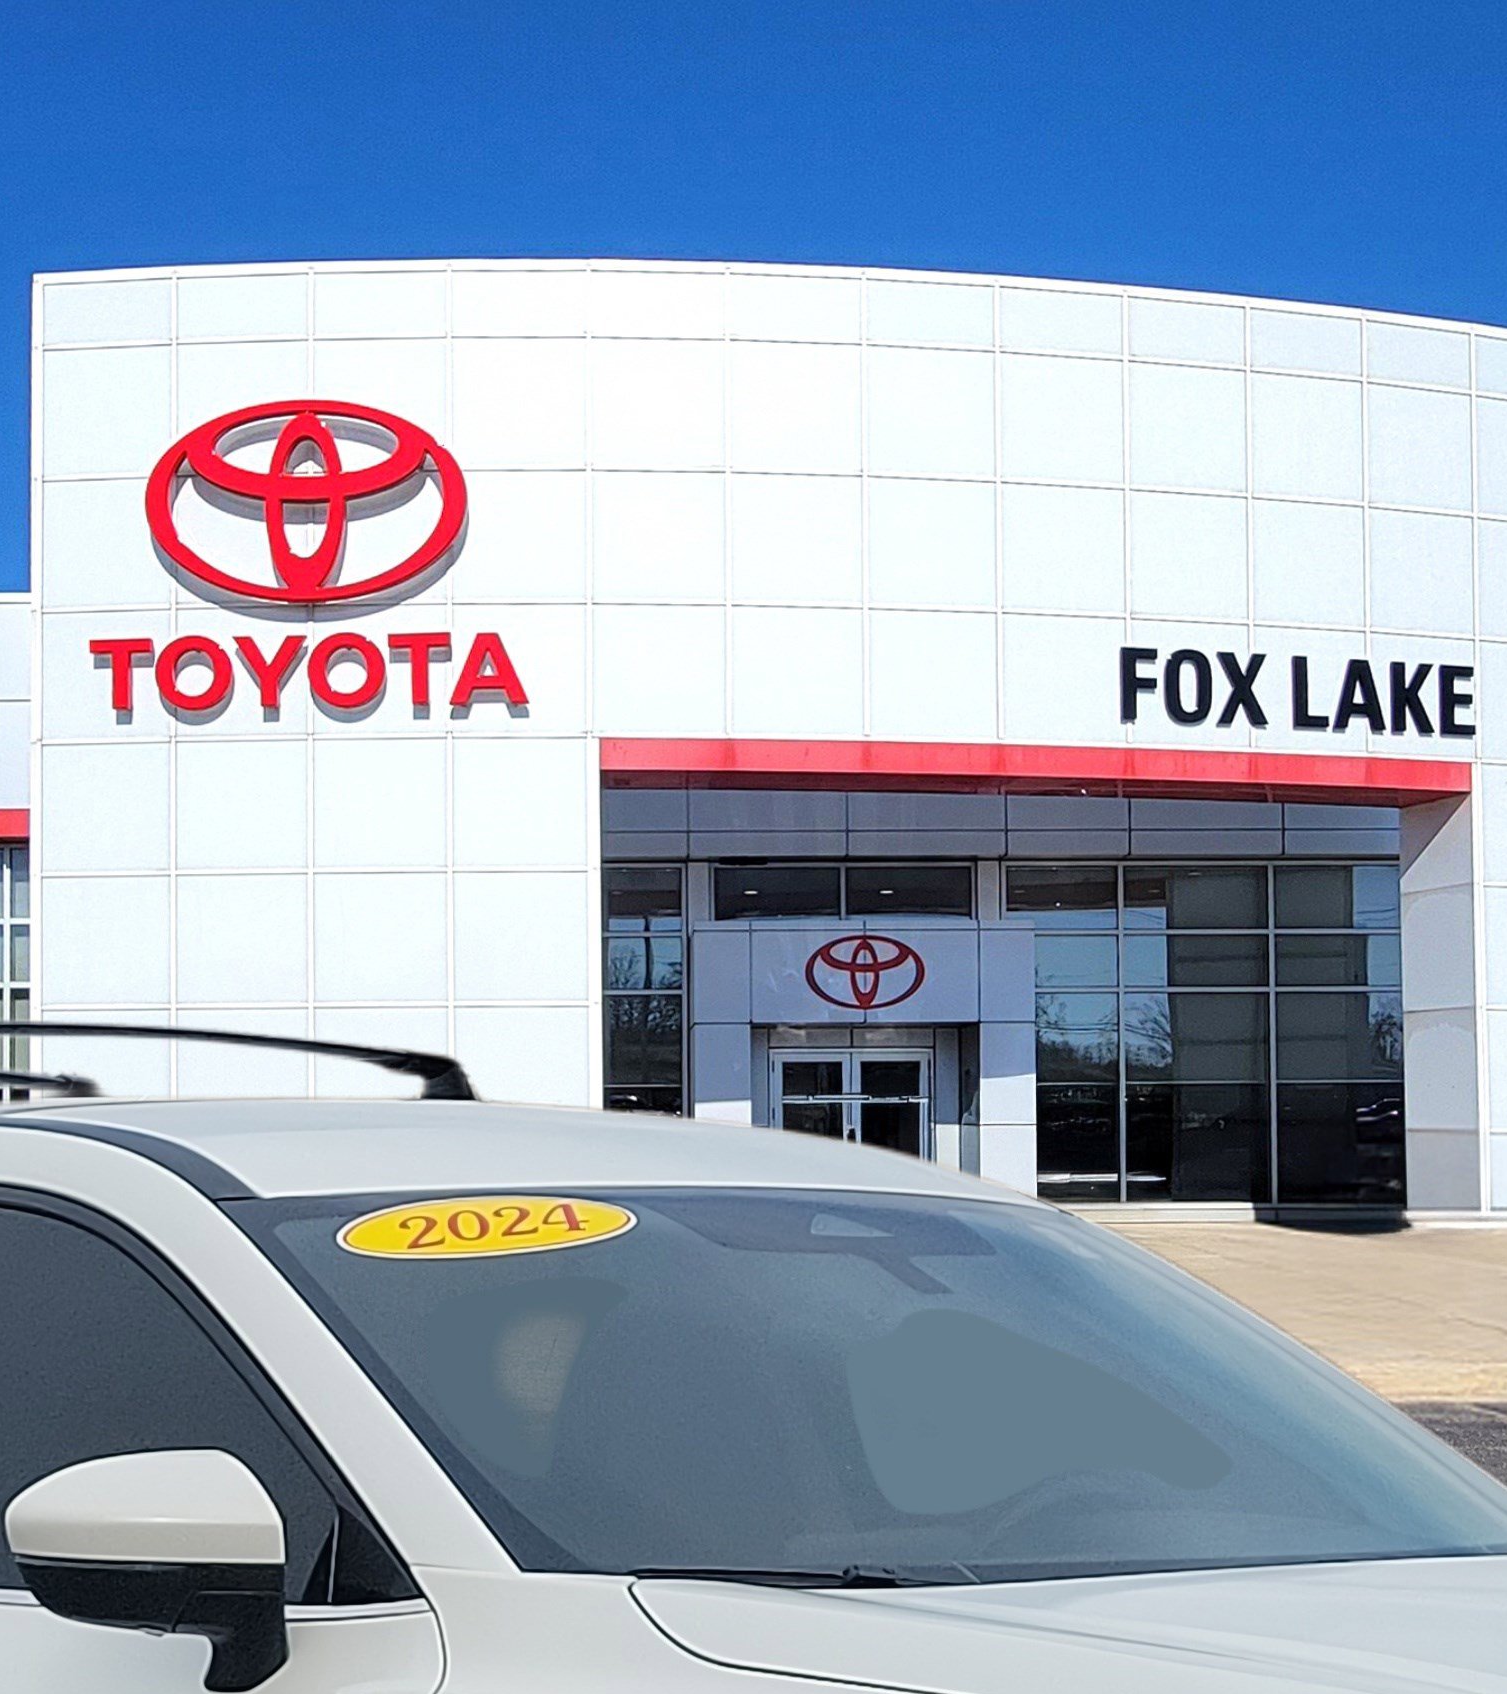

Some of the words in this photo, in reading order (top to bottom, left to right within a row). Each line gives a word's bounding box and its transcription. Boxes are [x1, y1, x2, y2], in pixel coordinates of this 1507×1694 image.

[89, 632, 528, 712] TOYOTA
[1120, 647, 1268, 727] FOX
[1292, 655, 1476, 736] LAKE
[398, 1203, 589, 1250] 2024
